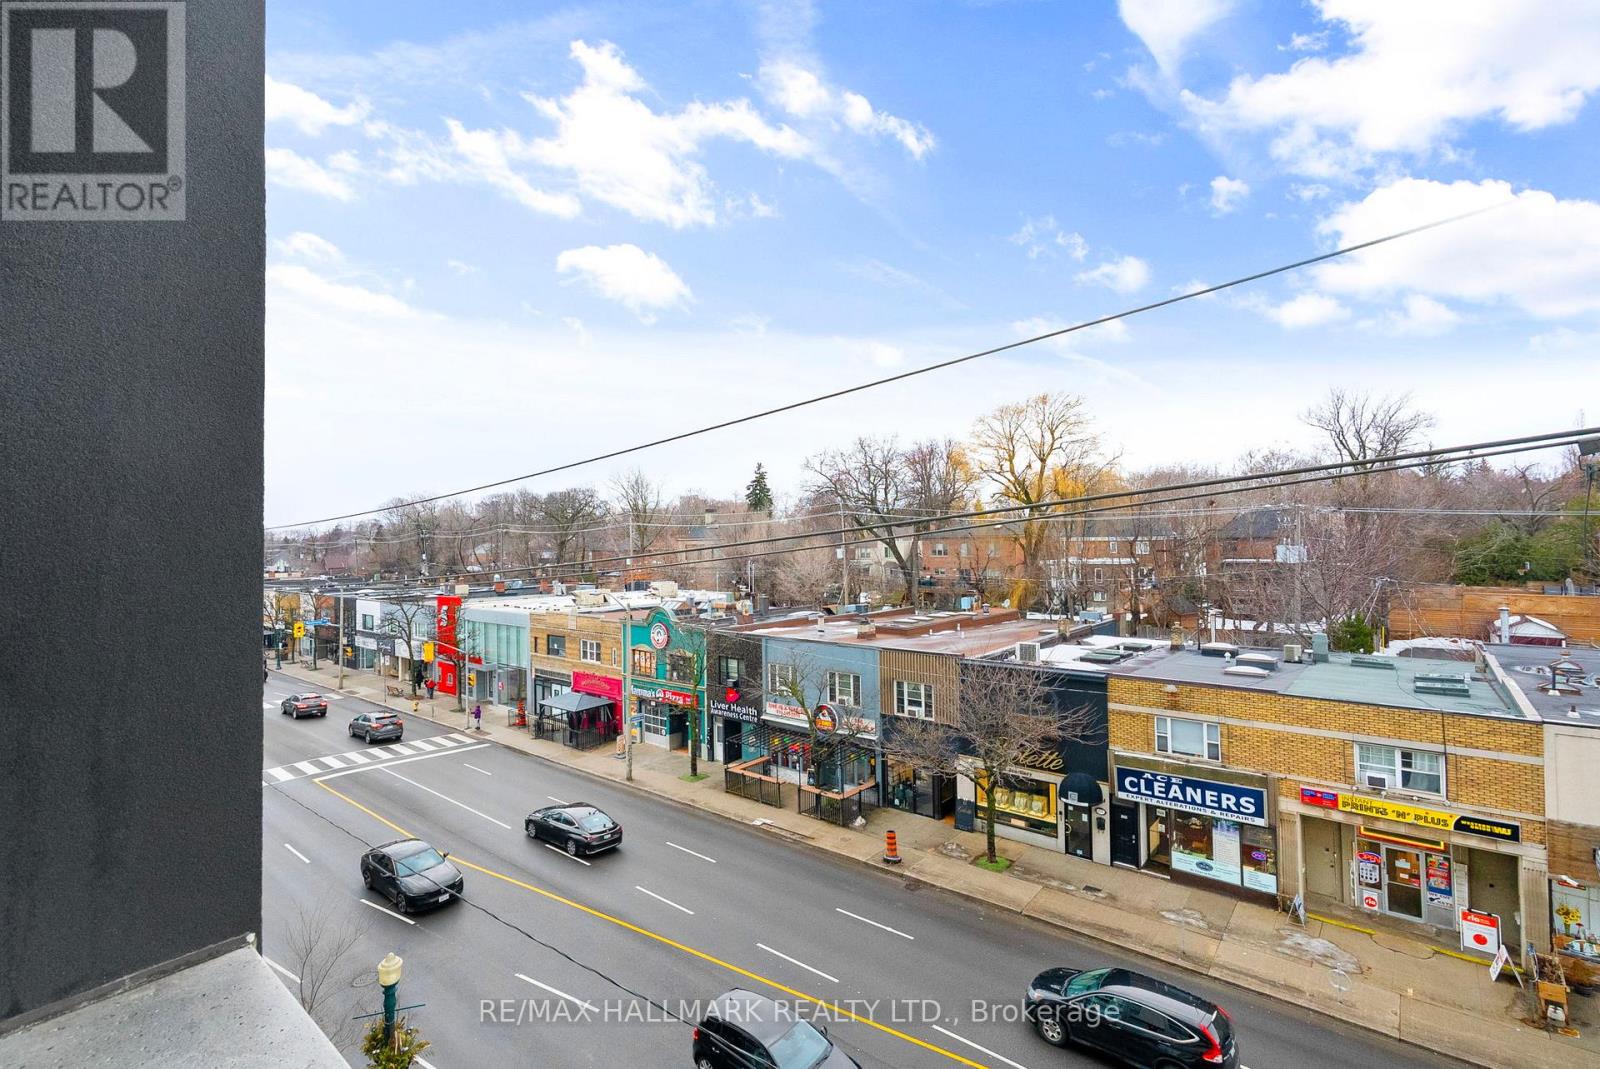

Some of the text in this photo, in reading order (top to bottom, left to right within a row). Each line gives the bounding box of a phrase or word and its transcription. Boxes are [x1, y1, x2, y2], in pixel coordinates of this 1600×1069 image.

[665, 690, 684, 705] Pizza
[710, 700, 729, 710] Liver
[731, 703, 758, 716] Health
[710, 708, 758, 723] Awareness Centre
[1142, 773, 1183, 784] ACE
[1124, 776, 1256, 814] CLEANERS
[1126, 794, 1153, 803] EXPERT
[1155, 800, 1208, 813] ALTERATIONS
[1219, 812, 1256, 823] REPAIRS
[1341, 800, 1389, 816] PRINTS
[1414, 814, 1449, 827] PLUS
[1357, 852, 1383, 864] OPEN
